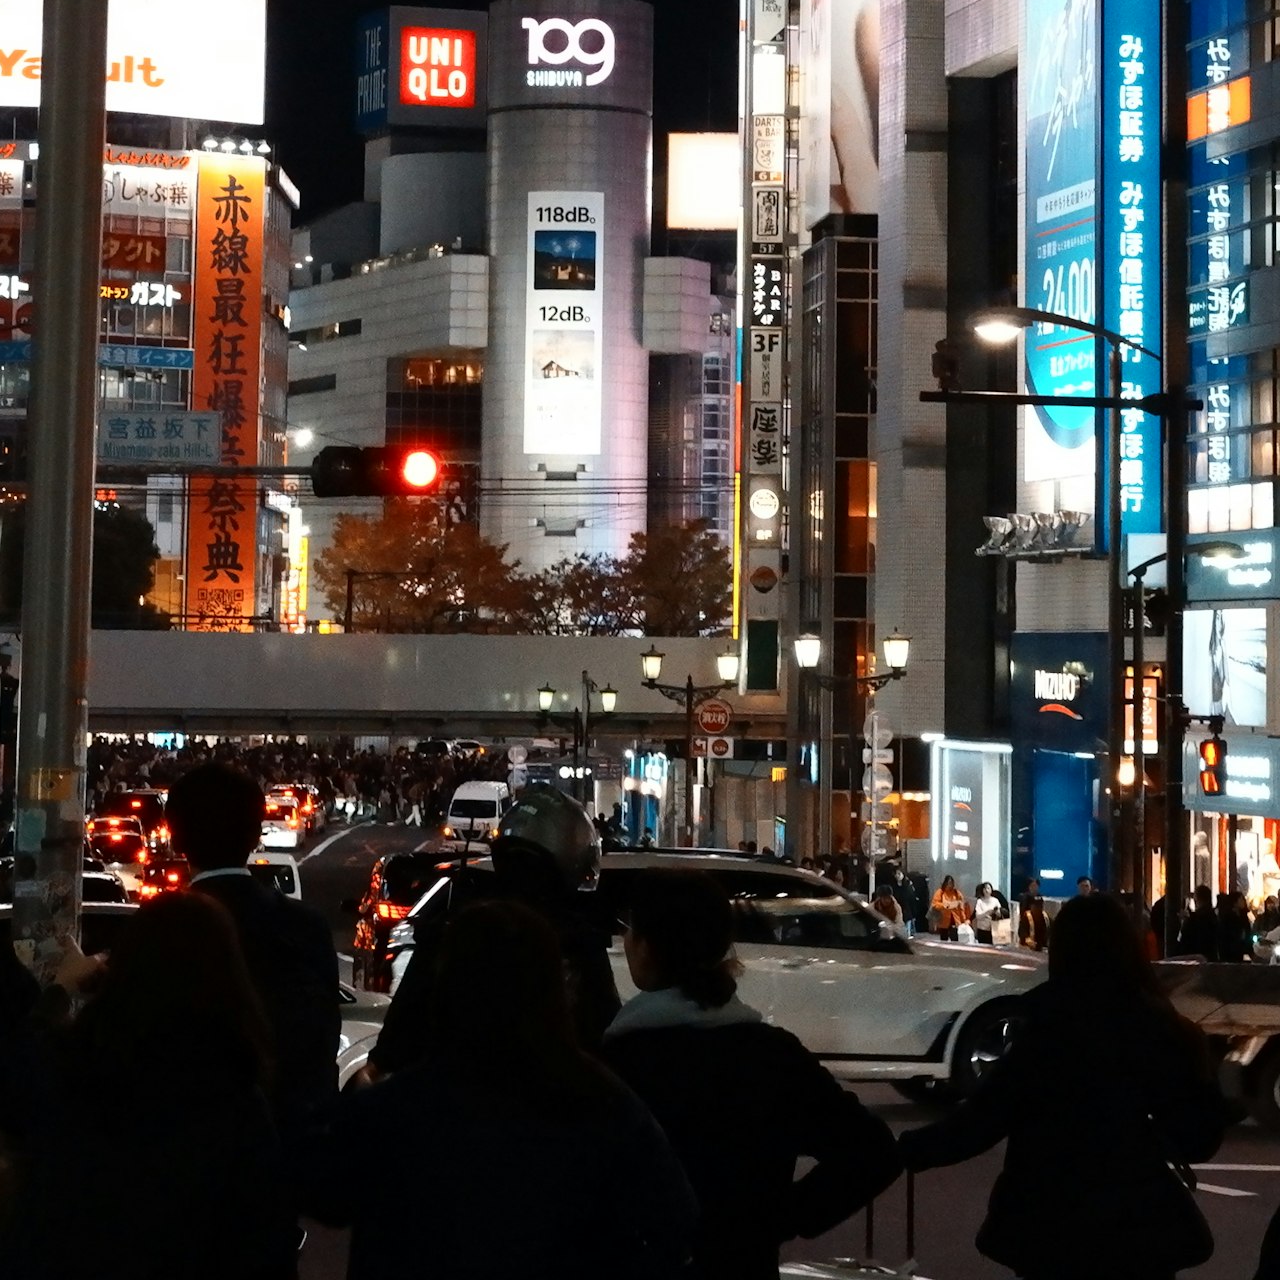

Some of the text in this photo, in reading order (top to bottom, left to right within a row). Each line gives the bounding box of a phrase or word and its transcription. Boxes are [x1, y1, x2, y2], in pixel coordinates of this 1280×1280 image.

[365, 25, 382, 69] THE
[408, 35, 463, 67] UNI
[521, 17, 616, 86] 109
[357, 69, 387, 116] PRIME
[407, 66, 468, 101] QLO
[526, 70, 582, 87] SHIBUYA
[1119, 33, 1144, 163] みずほ証券
[755, 116, 782, 128] DARTS
[121, 177, 189, 207] しゃぶ葉
[758, 243, 776, 255] 5F
[130, 280, 182, 308] ガスト
[752, 262, 767, 317] カラオケ
[770, 270, 781, 311] BAR
[1042, 257, 1095, 334] 24,00
[753, 333, 780, 353] 3F
[107, 416, 212, 440] 宮益坂下
[103, 442, 180, 458] Miyamasu-zaka
[1034, 670, 1078, 701] MIZUHO
